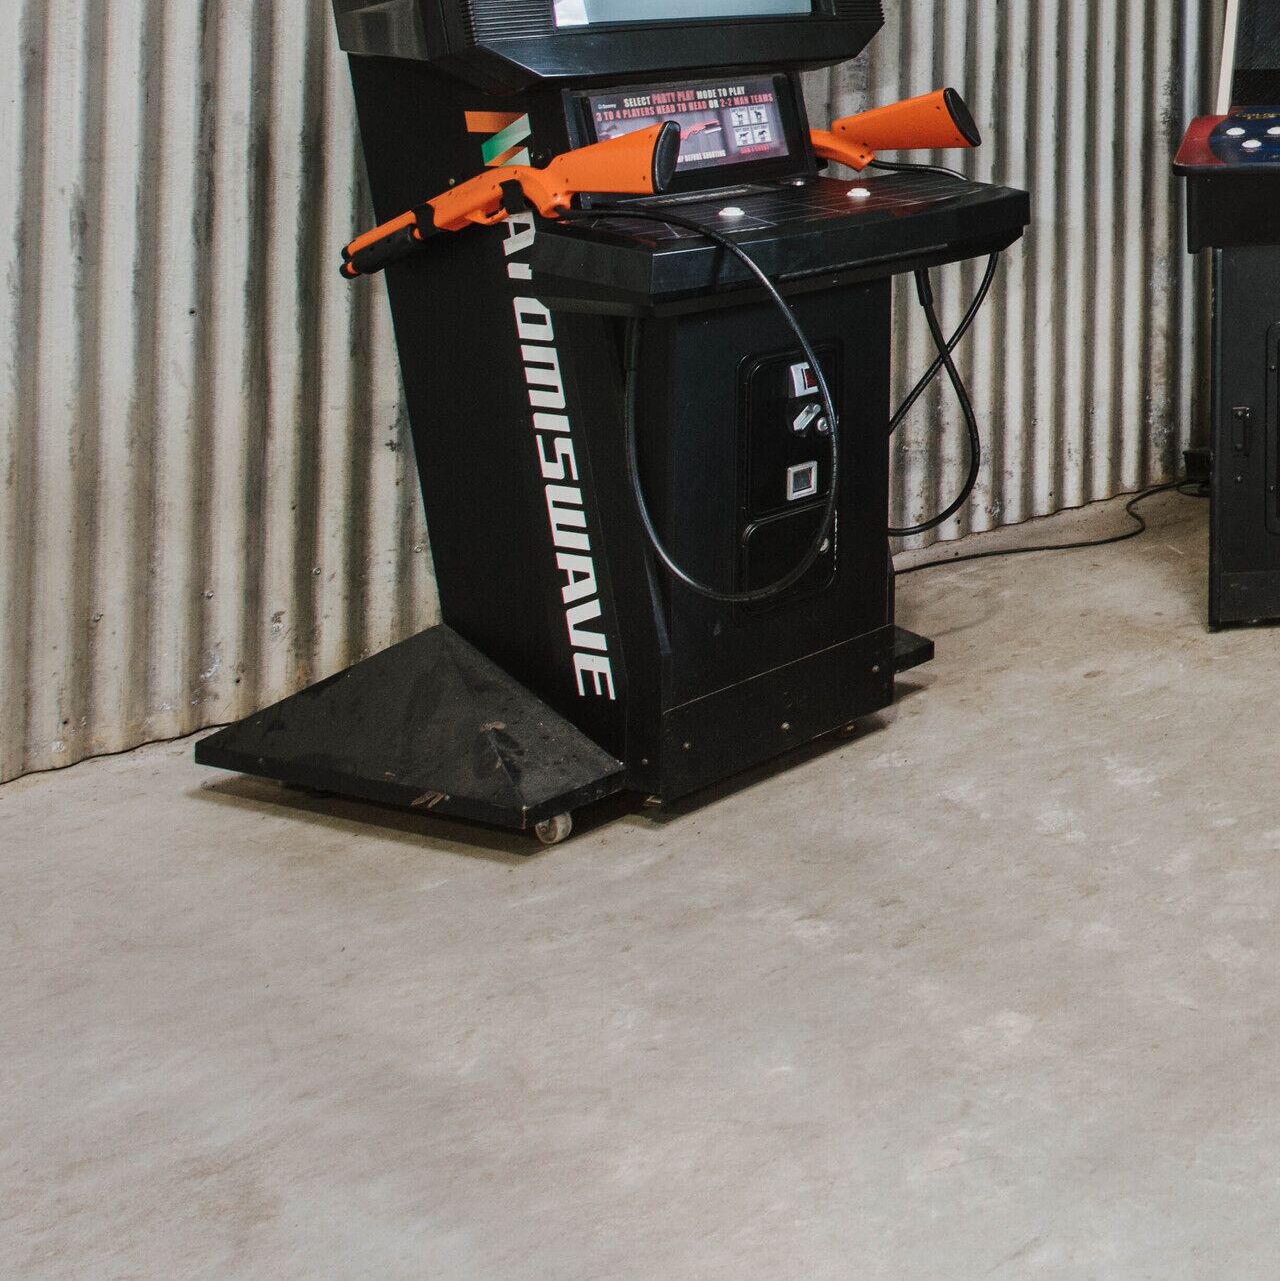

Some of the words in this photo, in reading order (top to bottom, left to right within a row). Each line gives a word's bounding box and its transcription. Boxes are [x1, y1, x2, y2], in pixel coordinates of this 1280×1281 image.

[595, 111, 602, 122] 3
[603, 110, 614, 120] TO
[615, 110, 621, 119] 4
[622, 106, 655, 119] PLAYERS
[656, 104, 676, 114] HEAD
[677, 103, 687, 112] TO
[688, 101, 707, 111] HEAD
[708, 99, 719, 109] OR
[750, 93, 774, 104] TEAMS
[623, 95, 651, 108] SELECT
[651, 91, 676, 105] PARTY
[677, 89, 695, 102] PLAY
[696, 88, 717, 99] MODE
[717, 87, 728, 97] TO
[728, 86, 745, 96] PLAY
